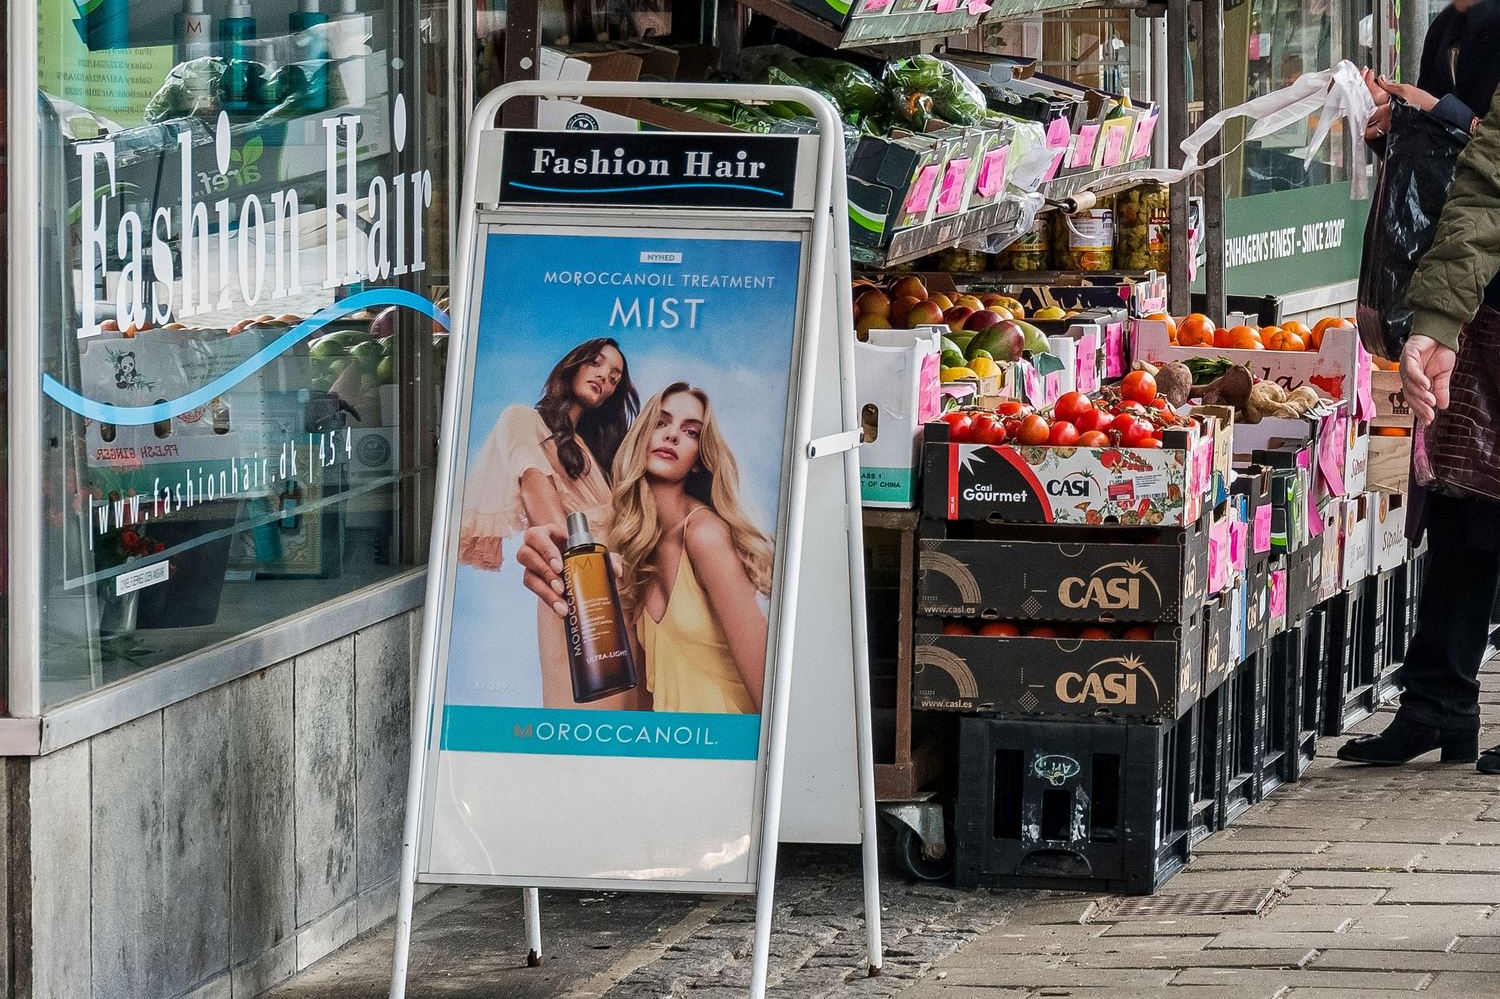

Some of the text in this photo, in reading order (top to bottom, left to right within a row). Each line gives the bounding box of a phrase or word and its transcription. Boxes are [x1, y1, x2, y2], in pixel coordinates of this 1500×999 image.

[531, 147, 766, 179] Fashion Hair
[76, 92, 432, 341] Fashion Hair
[1269, 227, 1296, 260] FINEST
[1302, 222, 1324, 254] SINCE
[647, 253, 675, 262] NYHED
[544, 271, 775, 289] MOROCCANOIL TREATMENT
[609, 296, 705, 329] MIST
[963, 490, 1028, 503] Gourmet
[975, 483, 993, 491] Casi
[1047, 479, 1090, 497] CASI
[1058, 577, 1140, 609] CASI
[564, 563, 582, 657] MOROCCANOIL
[924, 605, 976, 615] www.casi.es
[587, 650, 628, 665] ULTRA-LIGHT
[1055, 672, 1137, 705] CASI
[921, 699, 973, 709] www.casi.es
[512, 721, 719, 746] MOROCCANOIL
